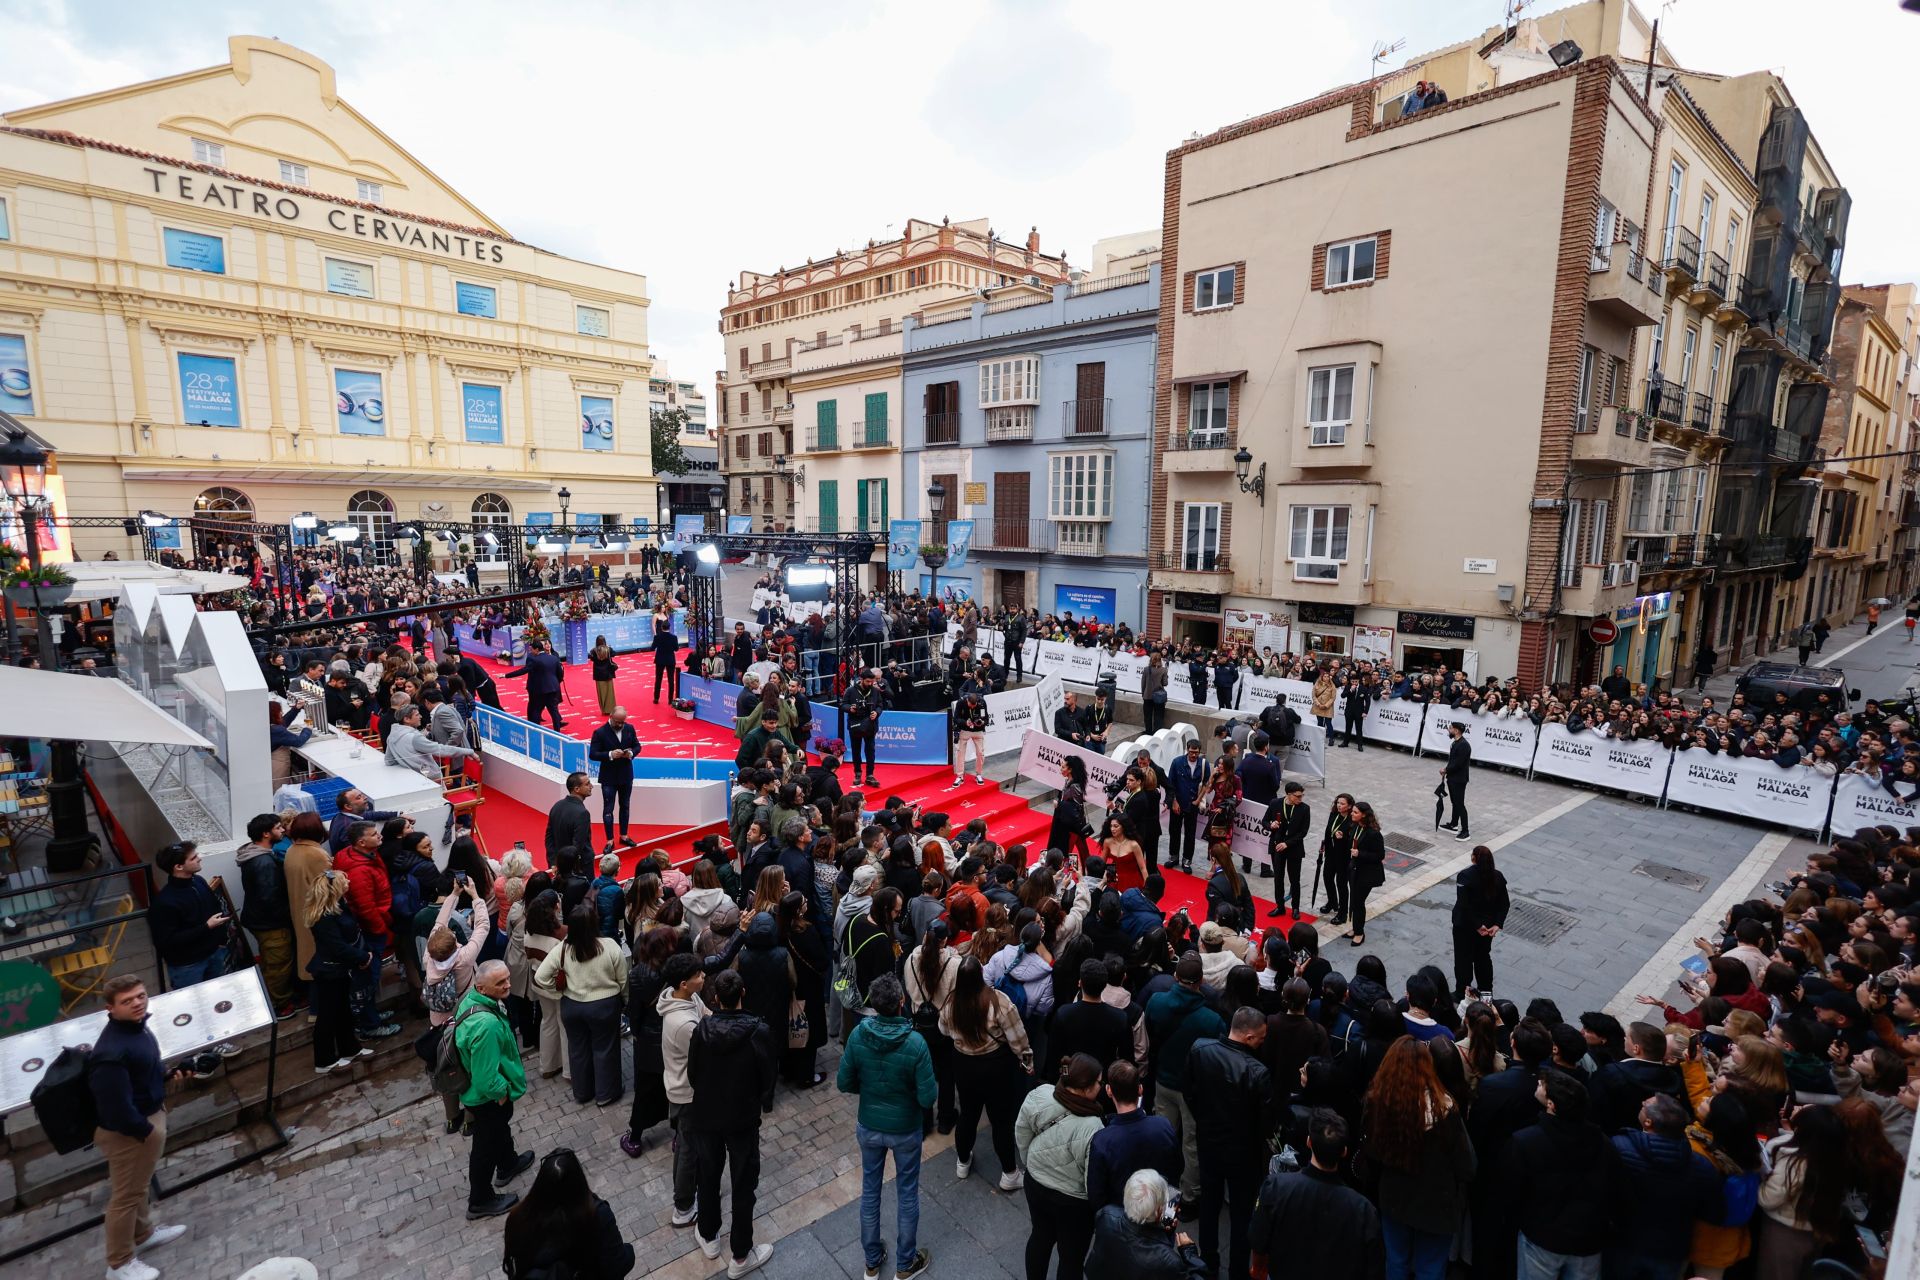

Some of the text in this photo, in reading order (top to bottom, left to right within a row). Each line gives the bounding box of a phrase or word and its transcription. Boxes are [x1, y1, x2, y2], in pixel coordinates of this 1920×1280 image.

[143, 167, 503, 263] TEATRO CERVANTES
[185, 371, 212, 390] 28
[187, 388, 219, 397] FESTIVAL
[467, 398, 485, 413] 28
[1432, 629, 1468, 638] CERVANTES
[1380, 708, 1402, 716] FESTIVAL
[1486, 727, 1512, 736] FESTIVAL
[1553, 739, 1582, 749] FESTIVAL
[1610, 750, 1641, 760] FESTIVAL
[1690, 765, 1724, 775] FESTIVAL
[1759, 777, 1797, 789] FESTIVAL
